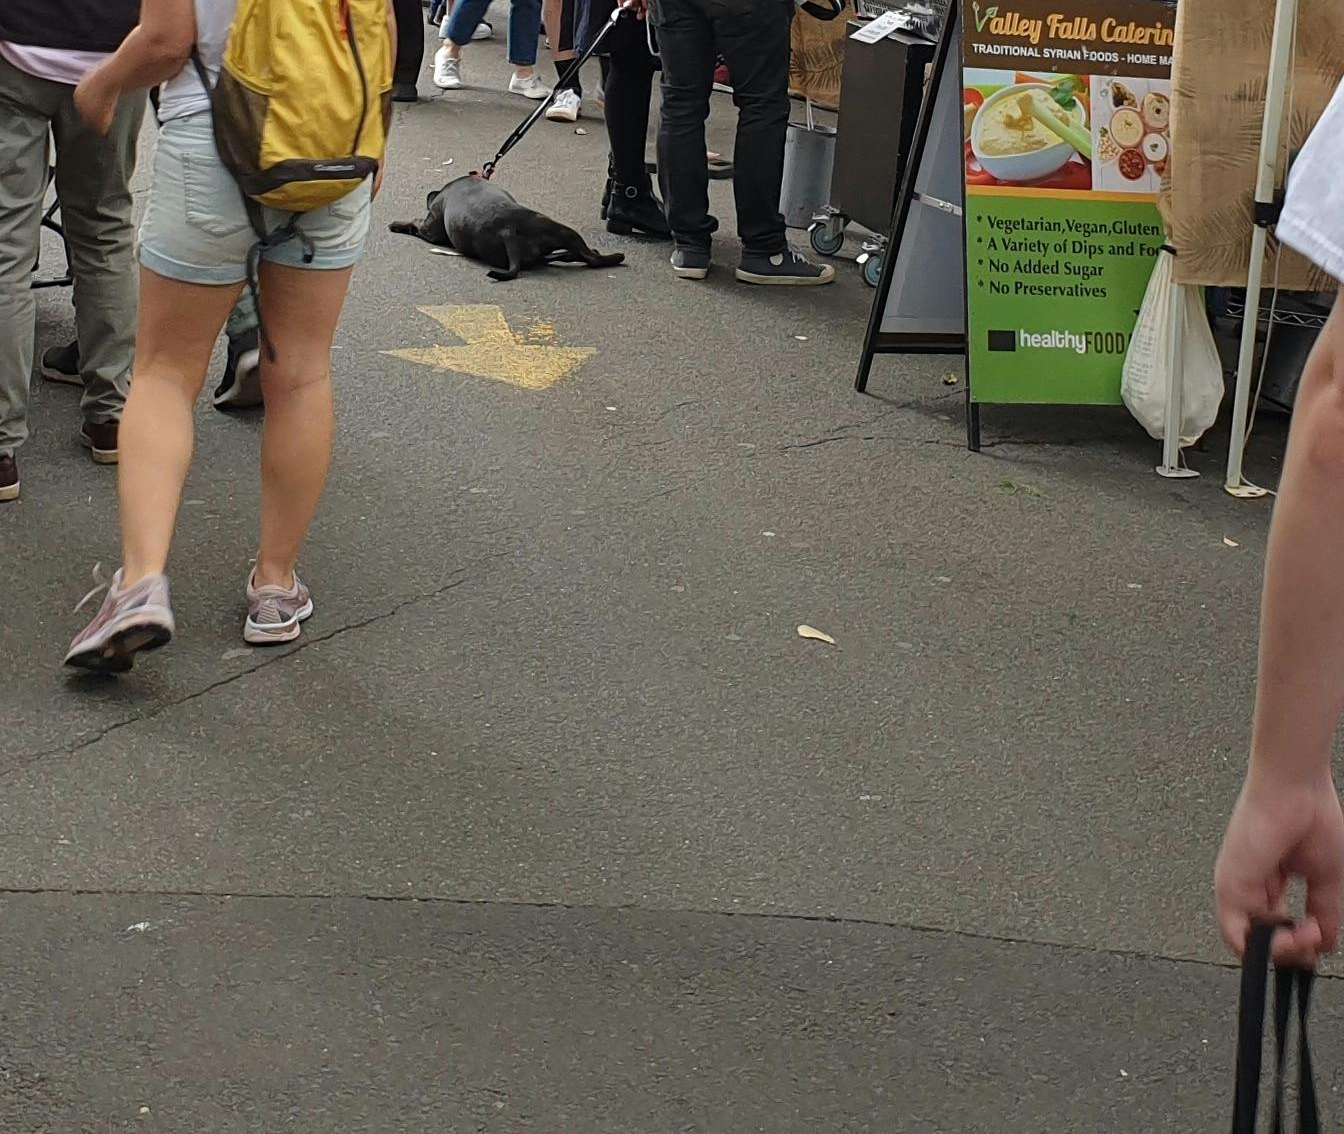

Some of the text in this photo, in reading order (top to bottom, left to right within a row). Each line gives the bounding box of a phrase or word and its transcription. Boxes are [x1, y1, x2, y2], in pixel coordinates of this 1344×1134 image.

[972, 1, 1042, 45] Valley
[1047, 12, 1097, 42] Falls
[972, 43, 1041, 58] TRADITIONAL
[1043, 48, 1081, 60] SYRIAN
[1083, 50, 1119, 63] FOODS
[1127, 55, 1157, 65] HOME
[987, 238, 998, 251] A
[1002, 237, 1051, 257] Variety
[1053, 240, 1067, 254] of
[1071, 239, 1104, 259] Dips
[1108, 242, 1135, 256] and
[989, 259, 1105, 280] No Added Sugar
[989, 280, 1108, 298] No Preservatives
